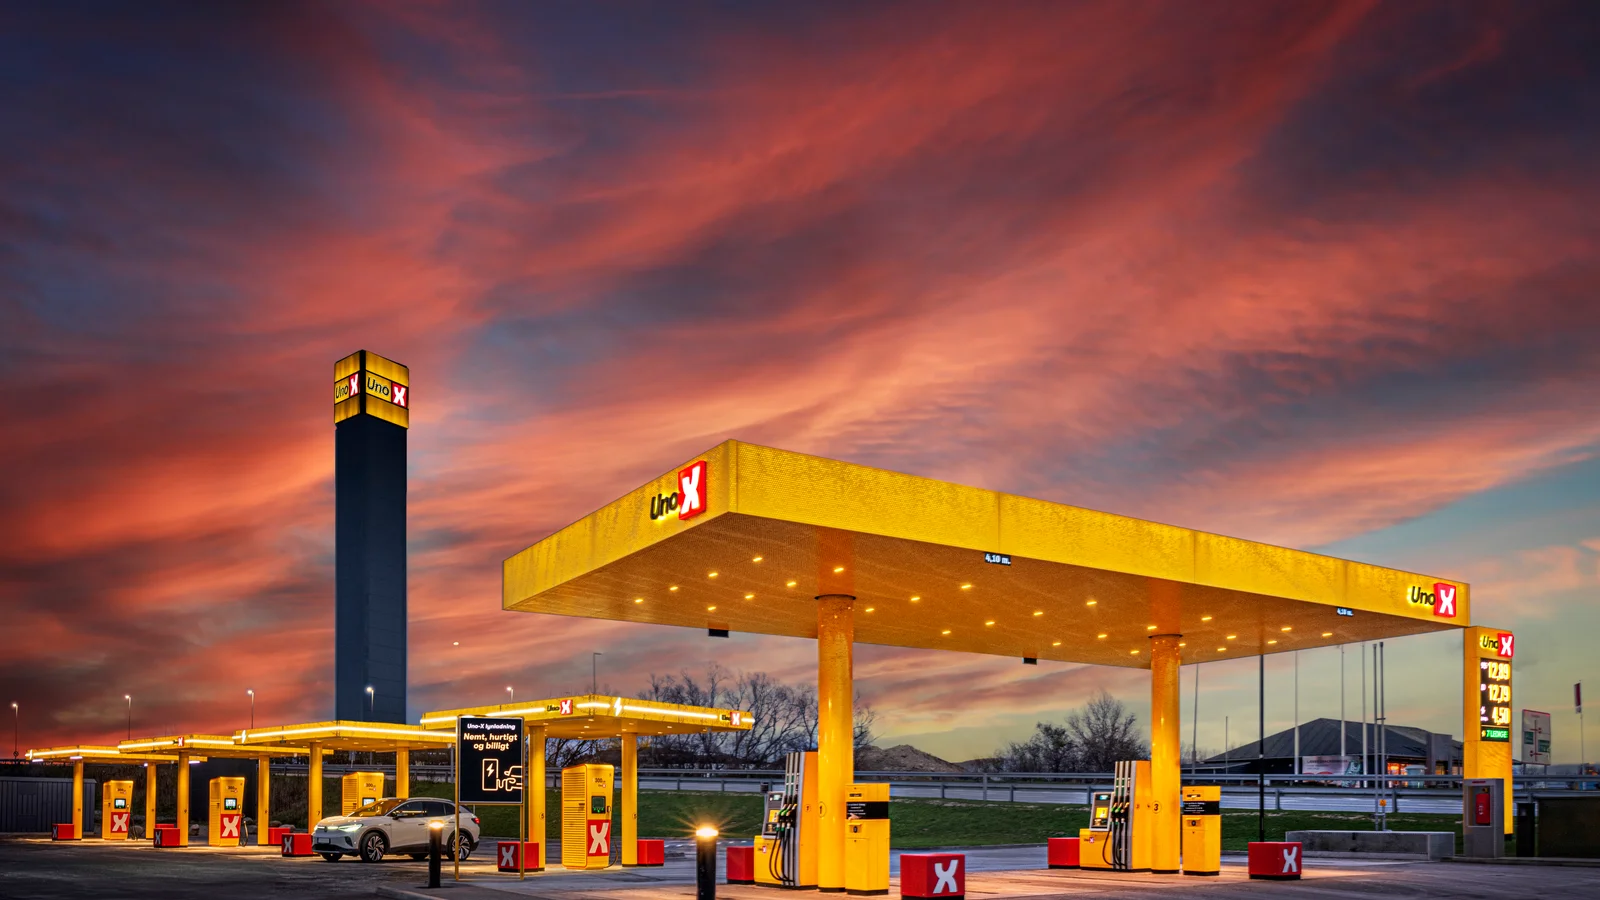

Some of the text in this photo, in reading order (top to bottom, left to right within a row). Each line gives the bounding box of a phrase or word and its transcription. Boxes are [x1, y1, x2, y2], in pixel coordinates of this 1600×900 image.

[350, 373, 358, 396] X
[367, 377, 406, 406] Uno X
[650, 465, 701, 520] Uno X
[985, 553, 1001, 563] 4,10
[1411, 586, 1455, 615] Uno X
[1482, 635, 1513, 656] Uno X
[1488, 683, 1511, 704] 12,79
[561, 700, 571, 715] X
[1492, 706, 1511, 726] 4,50
[463, 732, 518, 743] Nemt, hurtigt
[485, 723, 516, 731] lynladning
[473, 742, 510, 752] og billigt
[111, 813, 129, 832] X
[221, 815, 240, 837] X
[154, 830, 162, 845] X
[283, 836, 293, 853] X
[588, 822, 610, 854] X
[500, 845, 515, 867] X
[1282, 846, 1298, 873] X
[932, 859, 959, 894] X
